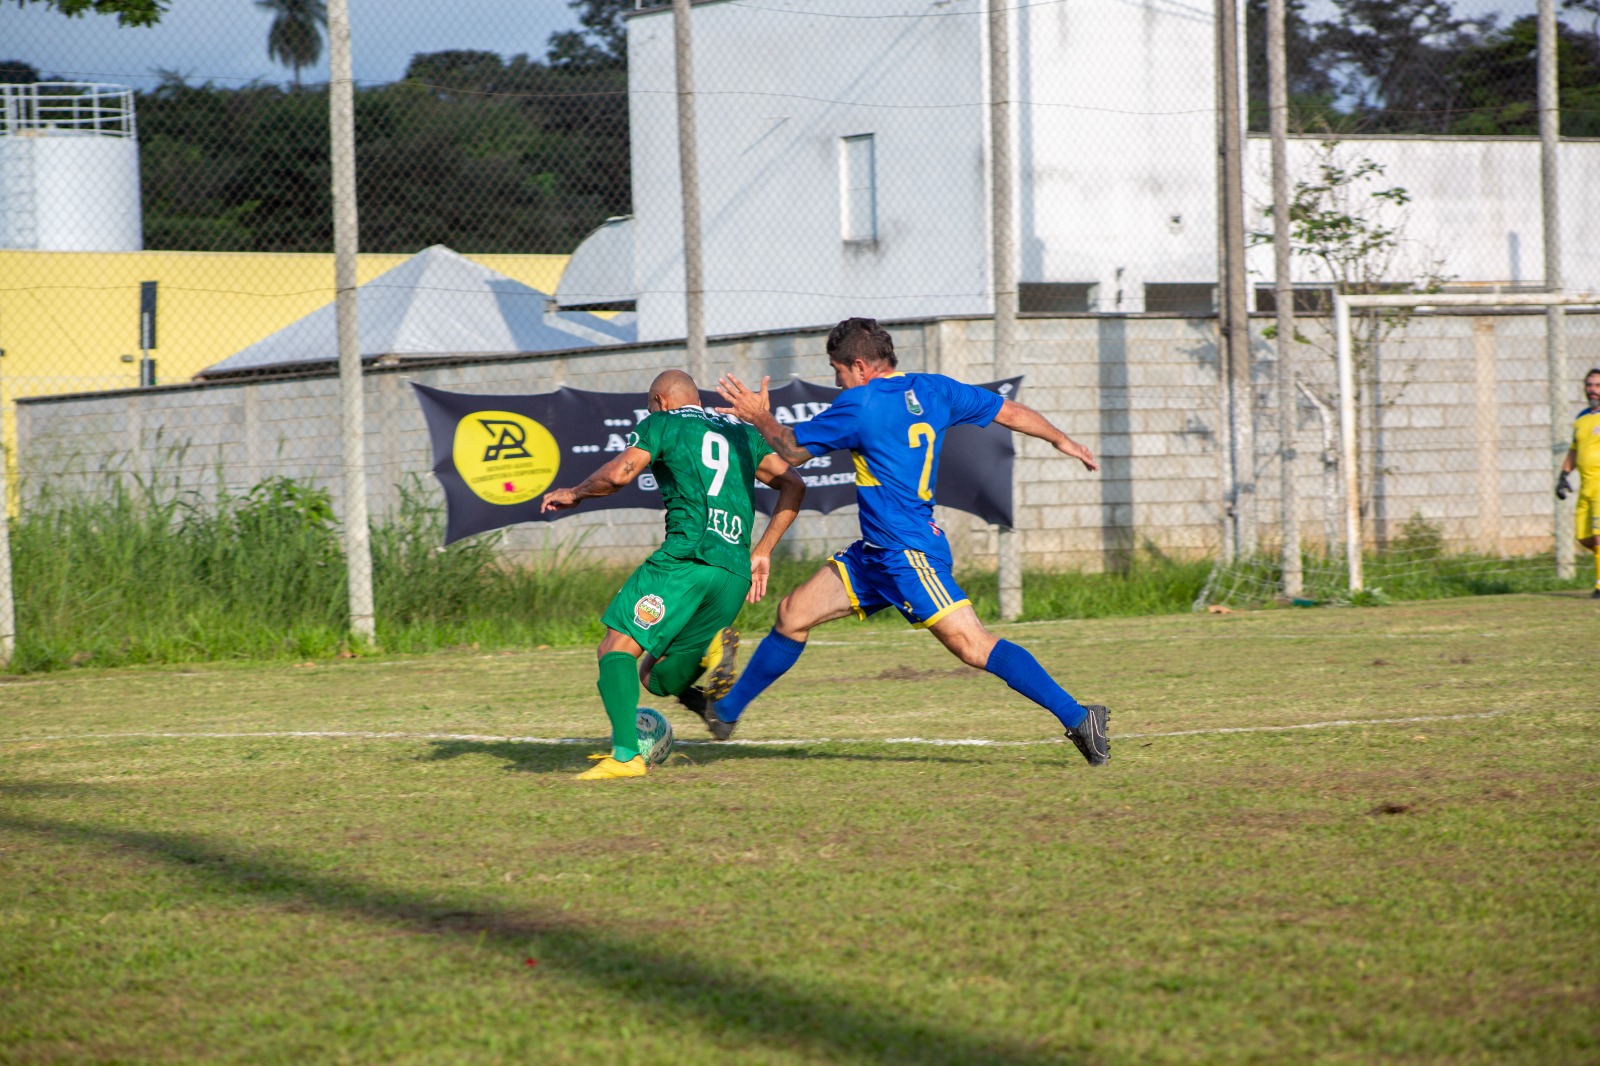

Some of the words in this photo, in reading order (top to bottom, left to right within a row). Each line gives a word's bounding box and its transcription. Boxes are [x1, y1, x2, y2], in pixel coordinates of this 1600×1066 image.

[775, 402, 833, 424] ALV
[701, 430, 730, 496] 9
[707, 508, 742, 540] ELO
